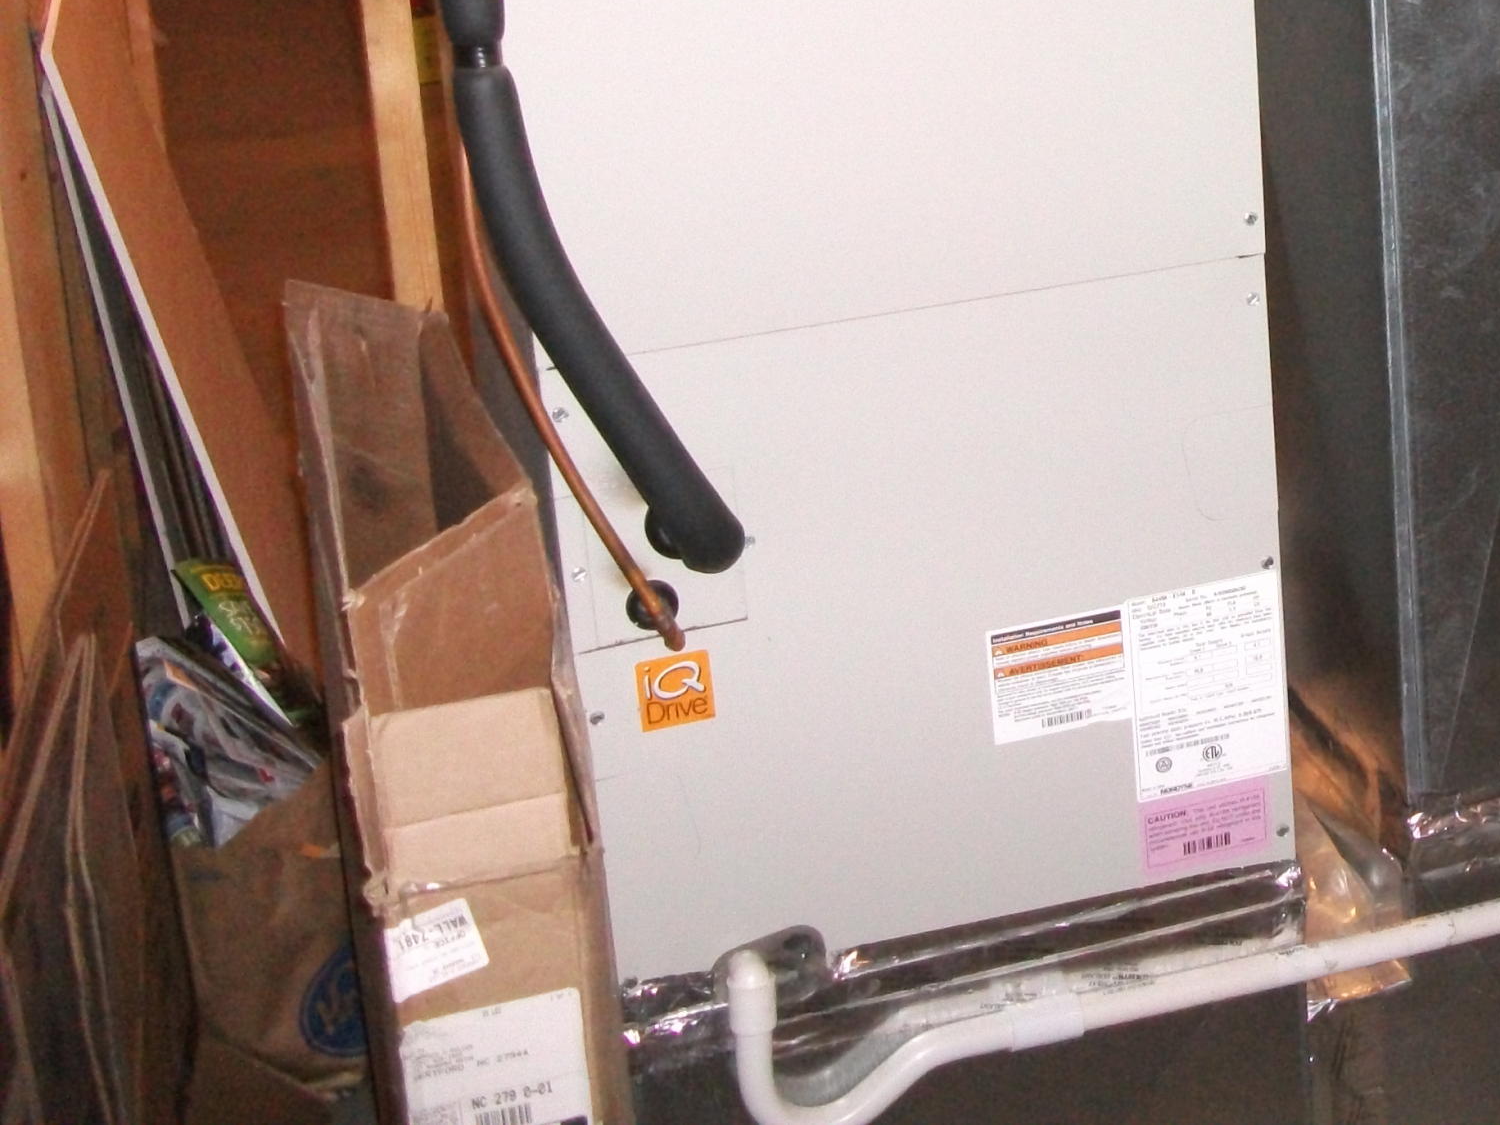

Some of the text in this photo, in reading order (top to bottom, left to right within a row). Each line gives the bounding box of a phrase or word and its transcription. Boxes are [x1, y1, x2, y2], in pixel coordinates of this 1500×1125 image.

[1006, 639, 1048, 654] WARNING
[1009, 655, 1082, 675] AVERTISSEMENT
[644, 660, 706, 701] iQ
[646, 696, 709, 725] Drive
[1147, 810, 1187, 825] CAUTION
[471, 1096, 488, 1110] NC
